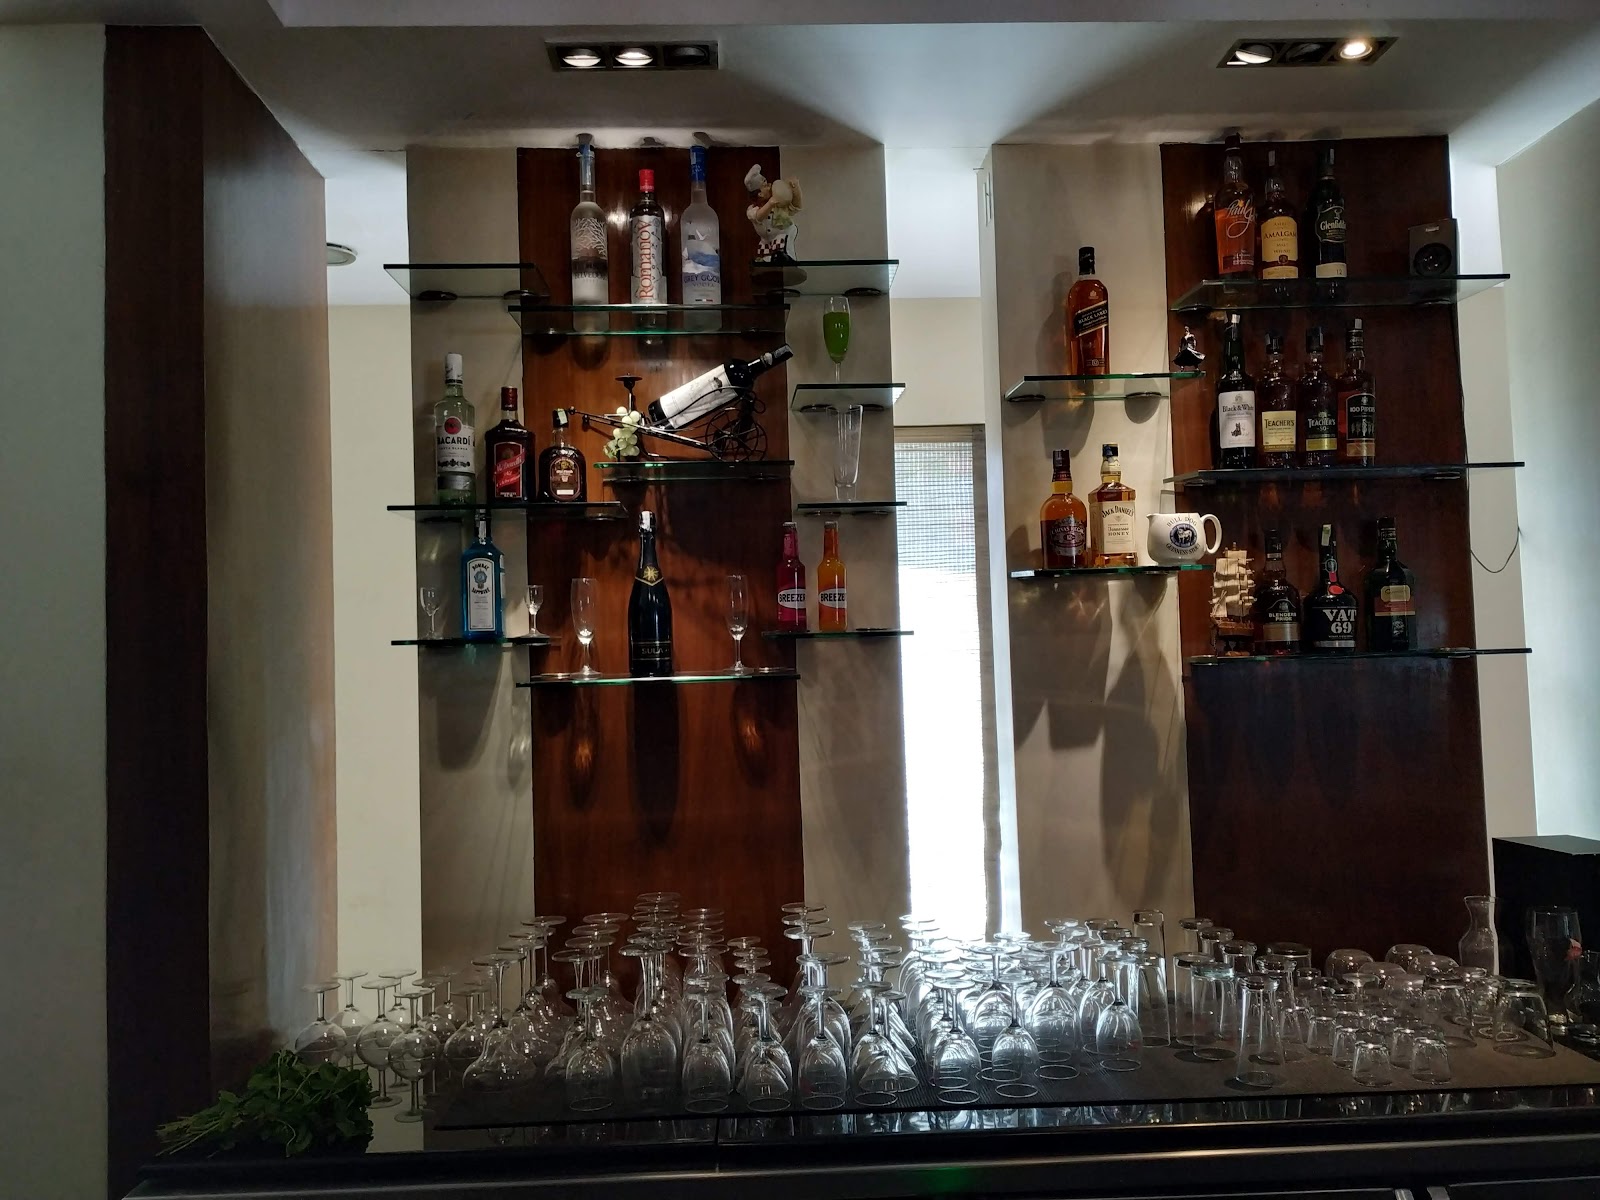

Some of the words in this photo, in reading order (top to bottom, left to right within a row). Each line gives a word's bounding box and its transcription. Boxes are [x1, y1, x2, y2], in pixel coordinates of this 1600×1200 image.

[1101, 507, 1114, 519] JACK
[1167, 516, 1182, 527] BULL
[1185, 516, 1197, 526] DOG
[1322, 609, 1357, 622] VAT
[1330, 621, 1353, 634] 69
